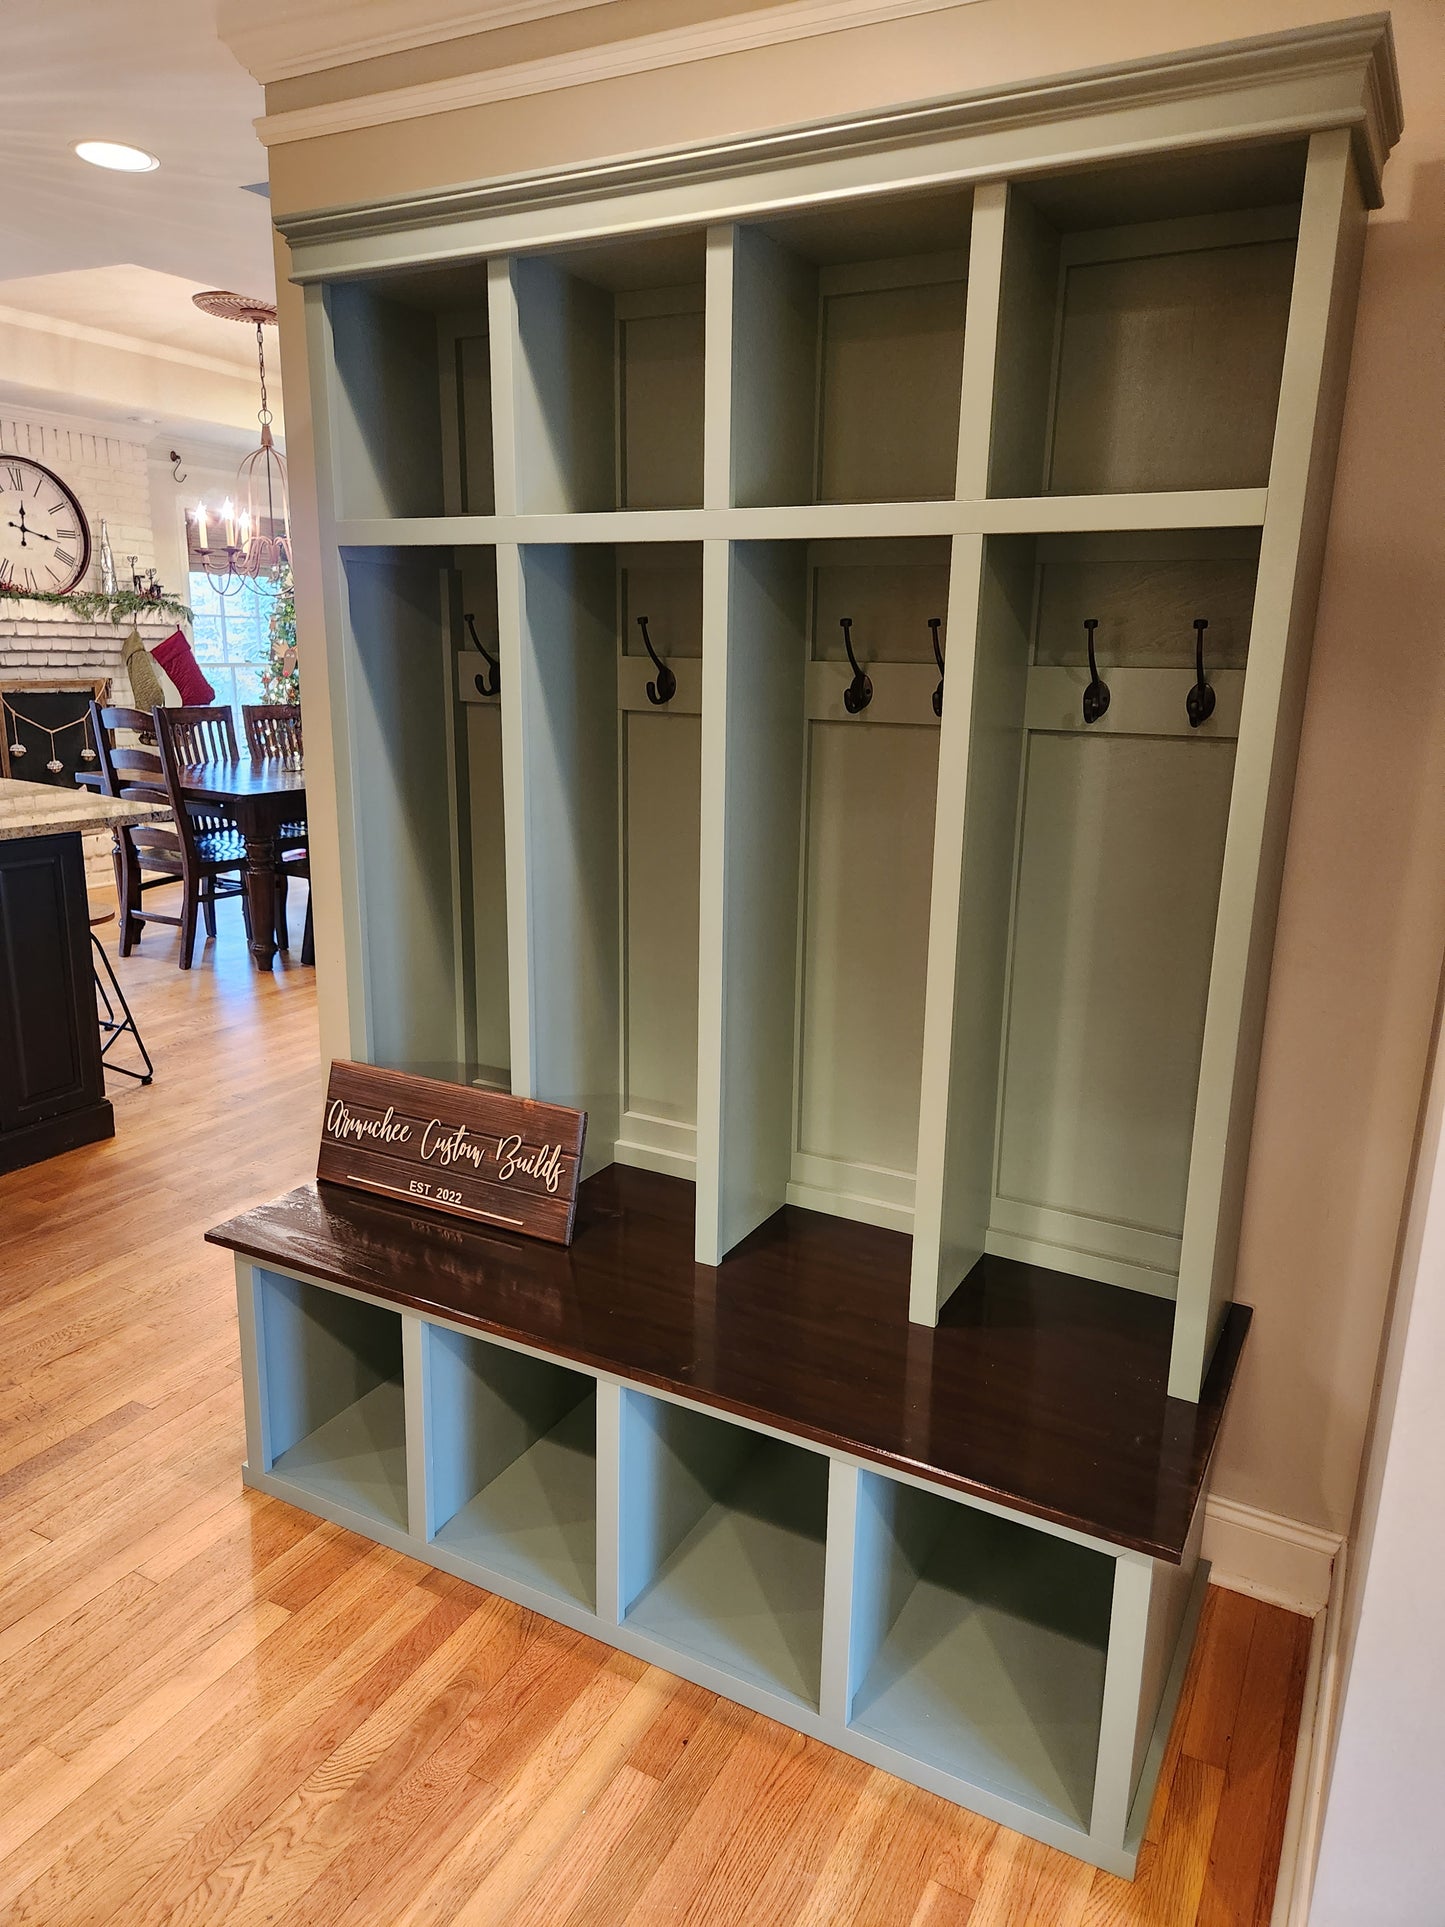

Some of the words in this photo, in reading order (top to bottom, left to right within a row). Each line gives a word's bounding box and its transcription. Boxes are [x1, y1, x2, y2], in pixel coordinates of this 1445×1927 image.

[327, 1099, 412, 1143] Armuchee
[420, 1118, 486, 1168] Custom
[495, 1134, 566, 1193] Builds
[409, 1180, 432, 1196] EST
[436, 1187, 463, 1204] 2022
